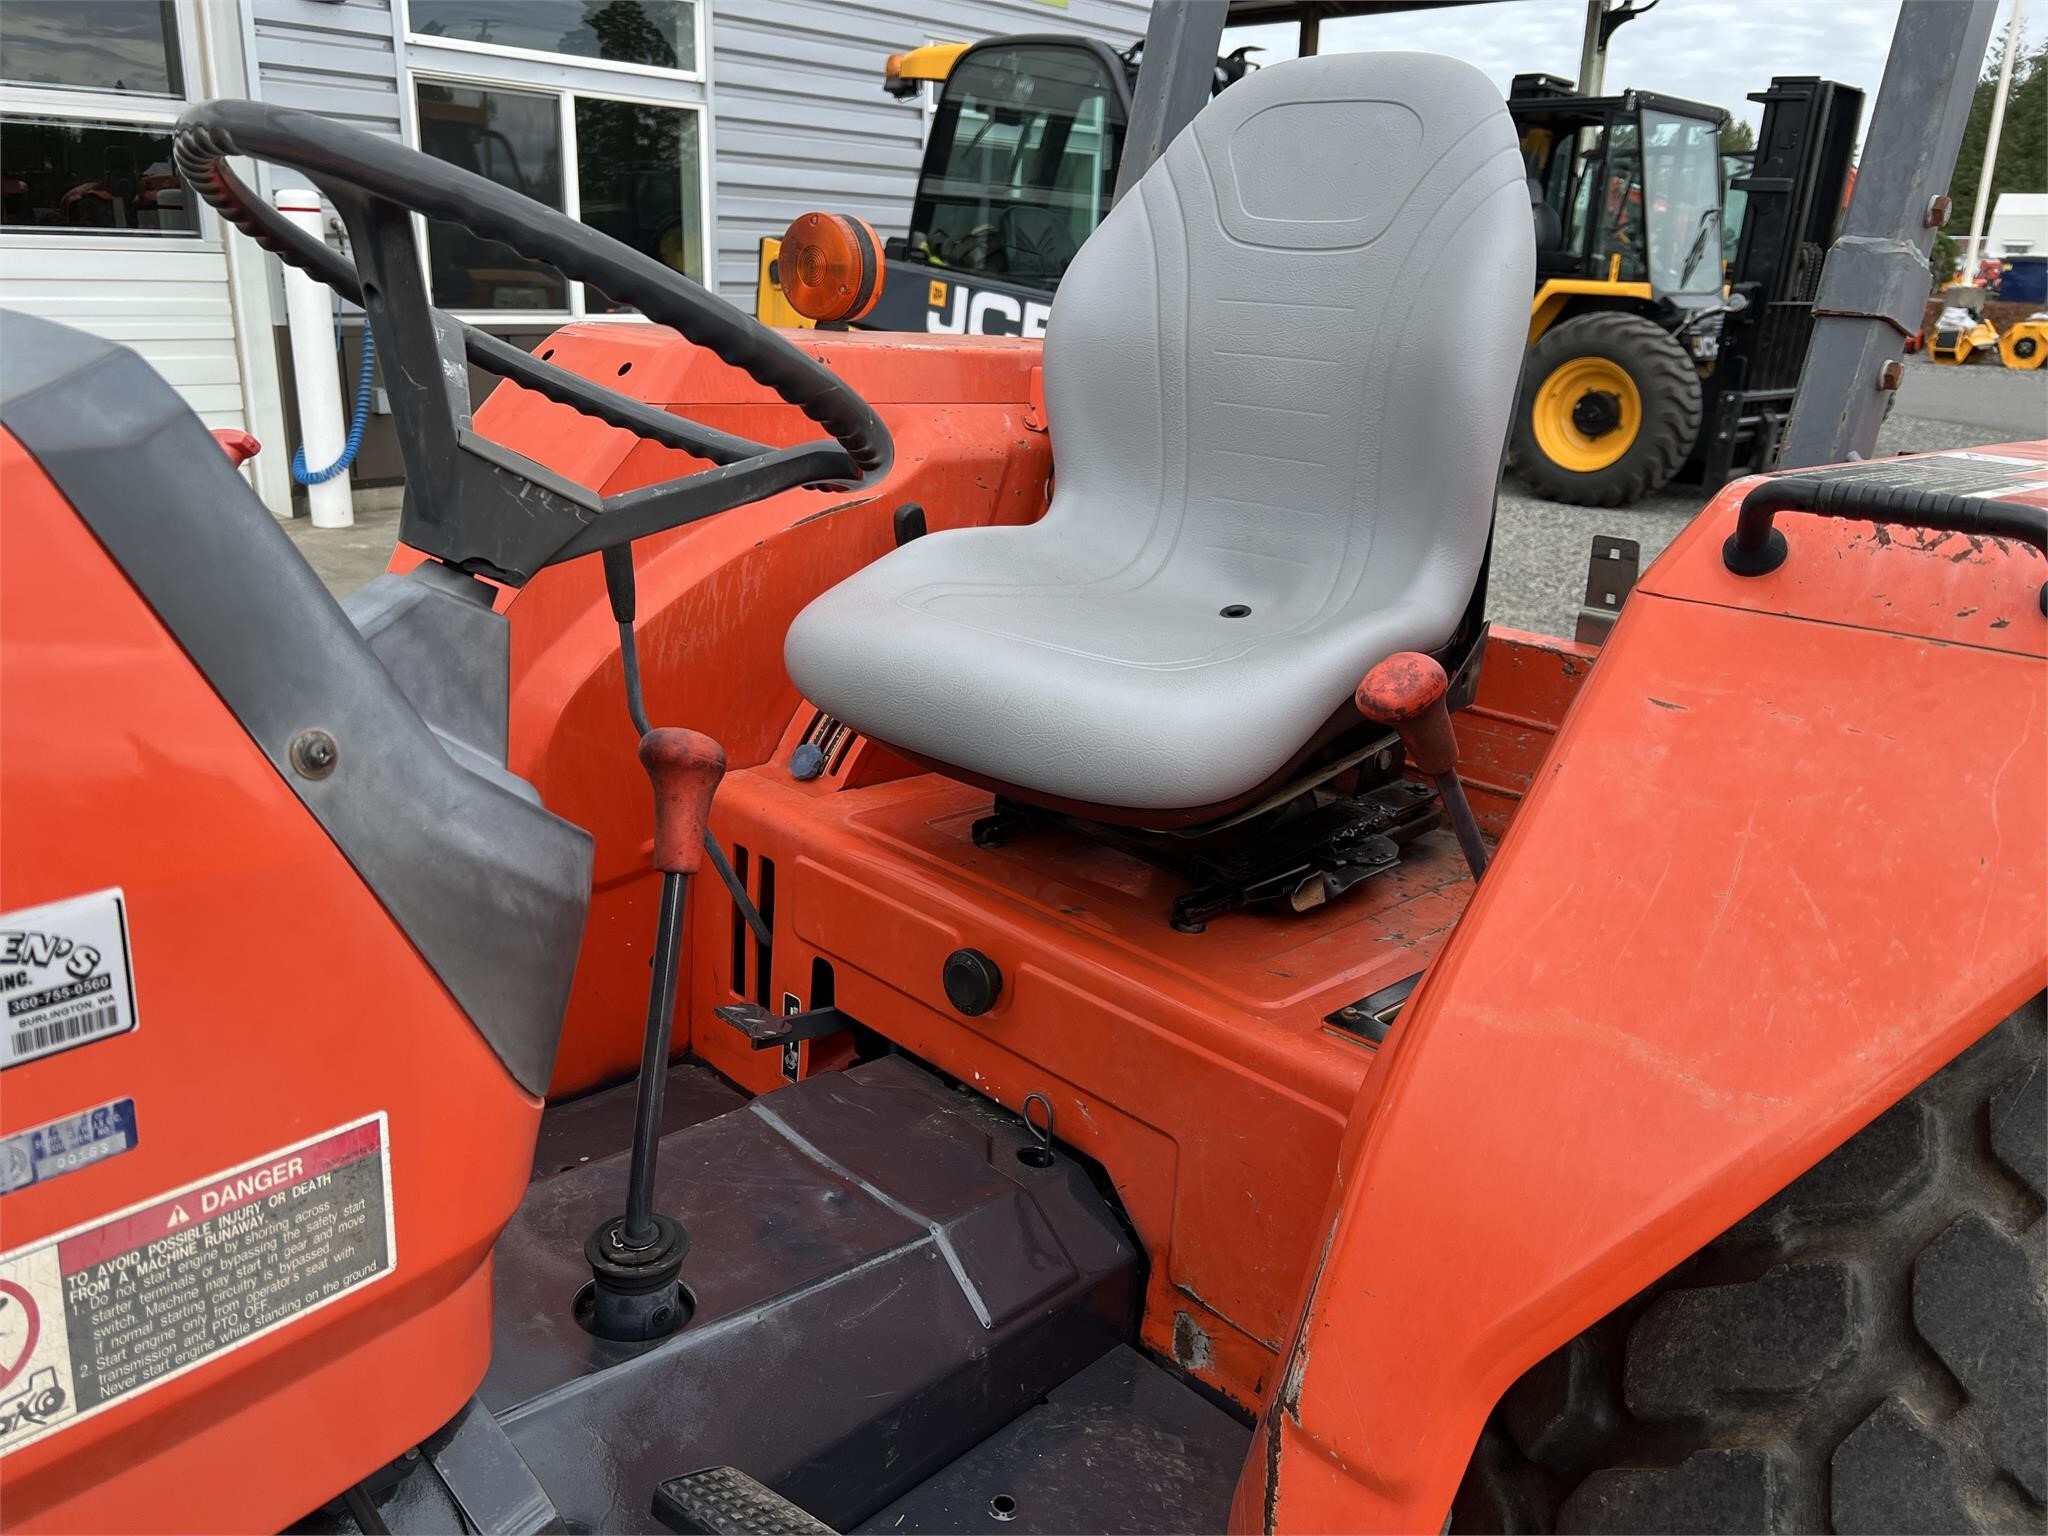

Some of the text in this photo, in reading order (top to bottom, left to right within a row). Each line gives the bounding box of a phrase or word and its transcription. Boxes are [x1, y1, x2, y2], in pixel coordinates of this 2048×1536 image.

[11, 976, 109, 1013] 360-755-0560
[97, 994, 115, 1006] WA
[67, 1172, 331, 1290] TO AVOID POSSIBLE INJURY OR DEATH
[201, 1156, 303, 1213] DANGER
[70, 1212, 267, 1304] FROM A MACHINE RUNAWAY.
[90, 1292, 108, 1309] Do
[115, 1281, 136, 1298] not
[143, 1266, 170, 1287] start
[178, 1248, 217, 1275] engine
[224, 1238, 238, 1255] by
[245, 1217, 288, 1246] shorting
[295, 1201, 329, 1222] across
[92, 1198, 365, 1325] starter terminals or bypassing the safety start
[146, 1285, 198, 1317] Machine
[205, 1274, 229, 1294] may
[236, 1258, 260, 1278] start
[268, 1251, 277, 1264] in
[284, 1240, 307, 1259] gear
[314, 1227, 332, 1243] and
[338, 1214, 365, 1232] move
[95, 1341, 103, 1354] if
[111, 1320, 152, 1348] normal
[160, 1298, 204, 1328] starting
[212, 1275, 256, 1305] circuitry
[264, 1268, 272, 1281] is
[96, 1347, 126, 1371] Start
[134, 1327, 175, 1356] engine
[182, 1312, 207, 1335] only
[214, 1298, 239, 1317] from
[246, 1271, 299, 1305] operators
[305, 1257, 327, 1276] seat
[333, 1244, 354, 1263] with
[99, 1341, 176, 1385] transmission
[183, 1327, 205, 1347] and
[212, 1312, 237, 1334] PTO
[101, 1258, 378, 1398] Never start engine while standing on the ground.
